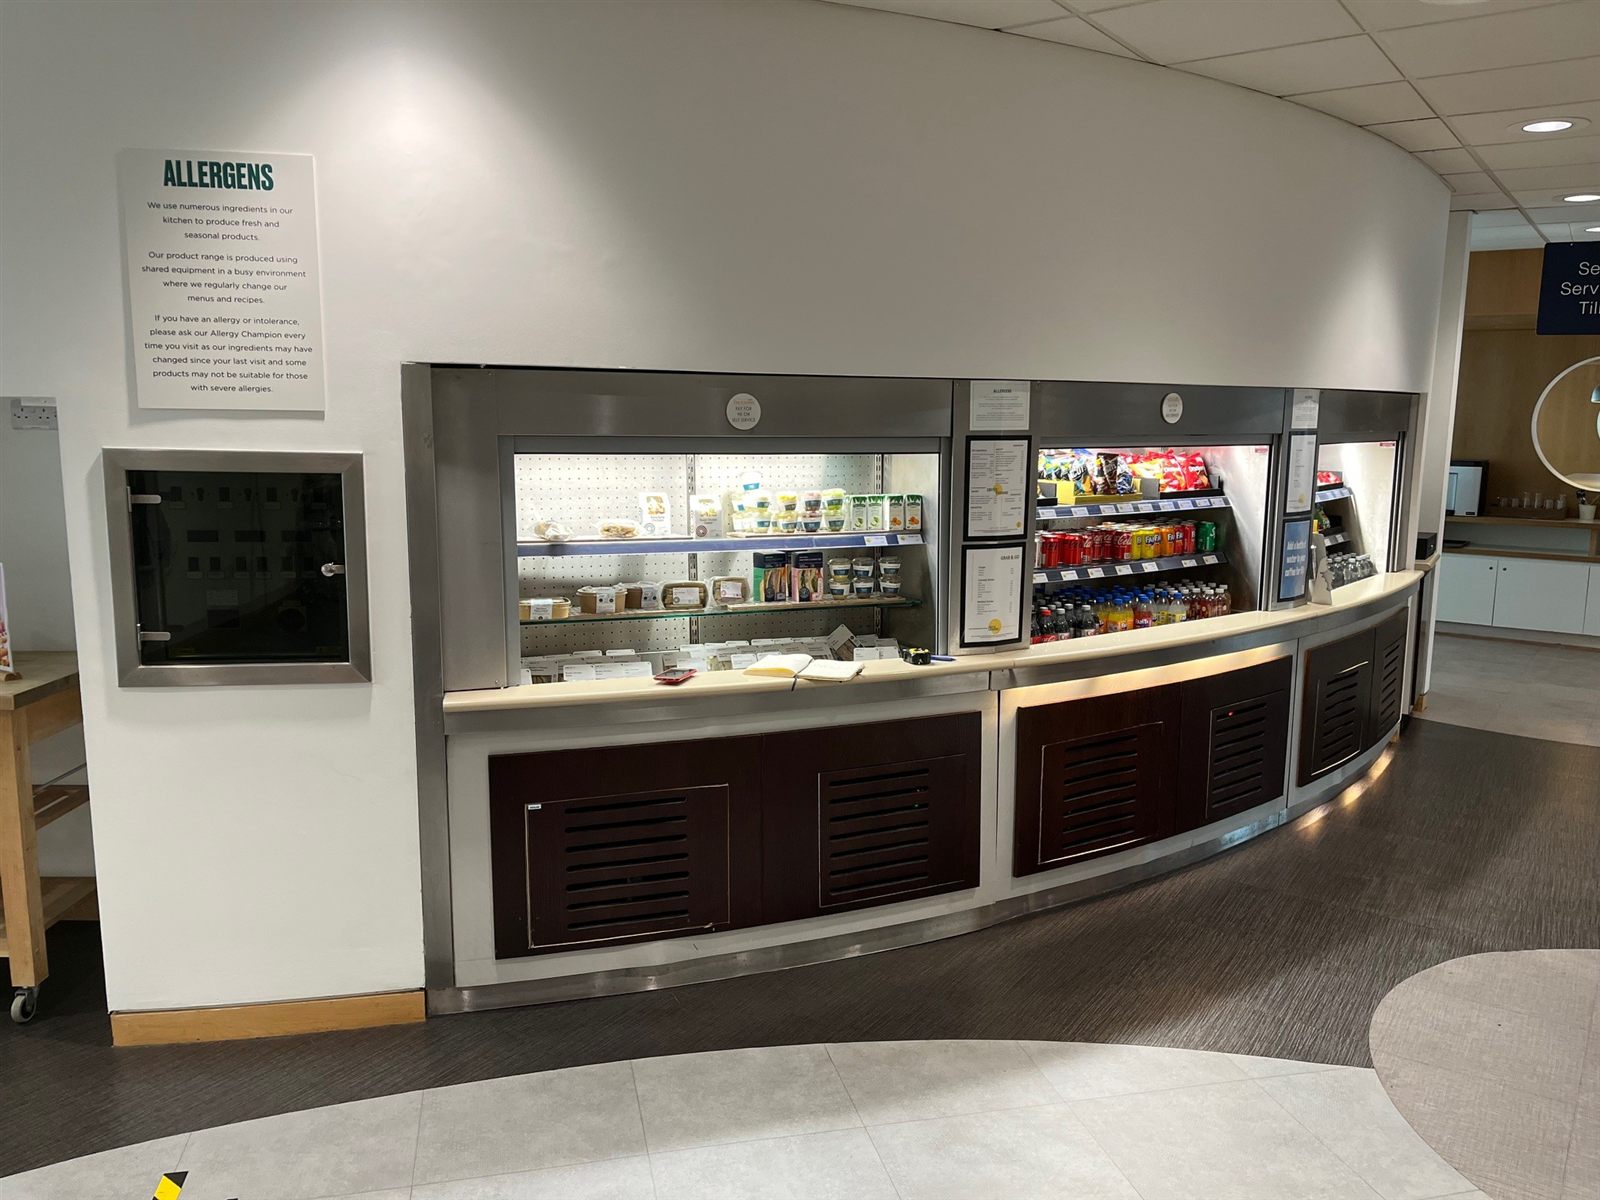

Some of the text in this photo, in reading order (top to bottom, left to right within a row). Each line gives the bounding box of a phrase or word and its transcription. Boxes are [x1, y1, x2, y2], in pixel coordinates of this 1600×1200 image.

[164, 160, 274, 191] ALLERGENS
[179, 204, 220, 212] numerous
[222, 205, 268, 215] ingredients
[162, 216, 193, 224] kitchen
[205, 217, 240, 227] produce
[242, 219, 263, 227] fresh
[184, 232, 220, 240] seasonal
[148, 251, 164, 259] Our
[166, 252, 199, 260] product
[201, 254, 225, 262] range
[235, 255, 274, 263] produced
[276, 257, 298, 265] using
[142, 265, 170, 273] shared
[171, 265, 216, 275] equipment
[217, 267, 226, 275] in
[234, 266, 254, 277] busy
[256, 270, 306, 278] environment
[162, 280, 188, 288] where
[204, 281, 240, 291] regularly
[242, 282, 272, 291] change
[273, 282, 287, 291] our
[216, 295, 232, 303] and
[154, 314, 160, 322] If
[179, 315, 199, 323] have
[213, 316, 241, 325] allergy
[150, 328, 176, 336] please
[210, 330, 240, 339] Allergy
[241, 330, 283, 340] Champion
[144, 342, 163, 350] time
[164, 343, 181, 351] you
[228, 344, 274, 353] ingredients
[274, 346, 293, 354] may
[294, 345, 313, 353] have
[152, 355, 188, 365] changed
[212, 358, 231, 366] your
[233, 357, 248, 366] last
[268, 358, 283, 366] and
[153, 368, 190, 378] products
[191, 371, 209, 379] may
[226, 371, 238, 379] be
[286, 372, 308, 380] those
[190, 384, 209, 392] with
[210, 384, 237, 392] severe
